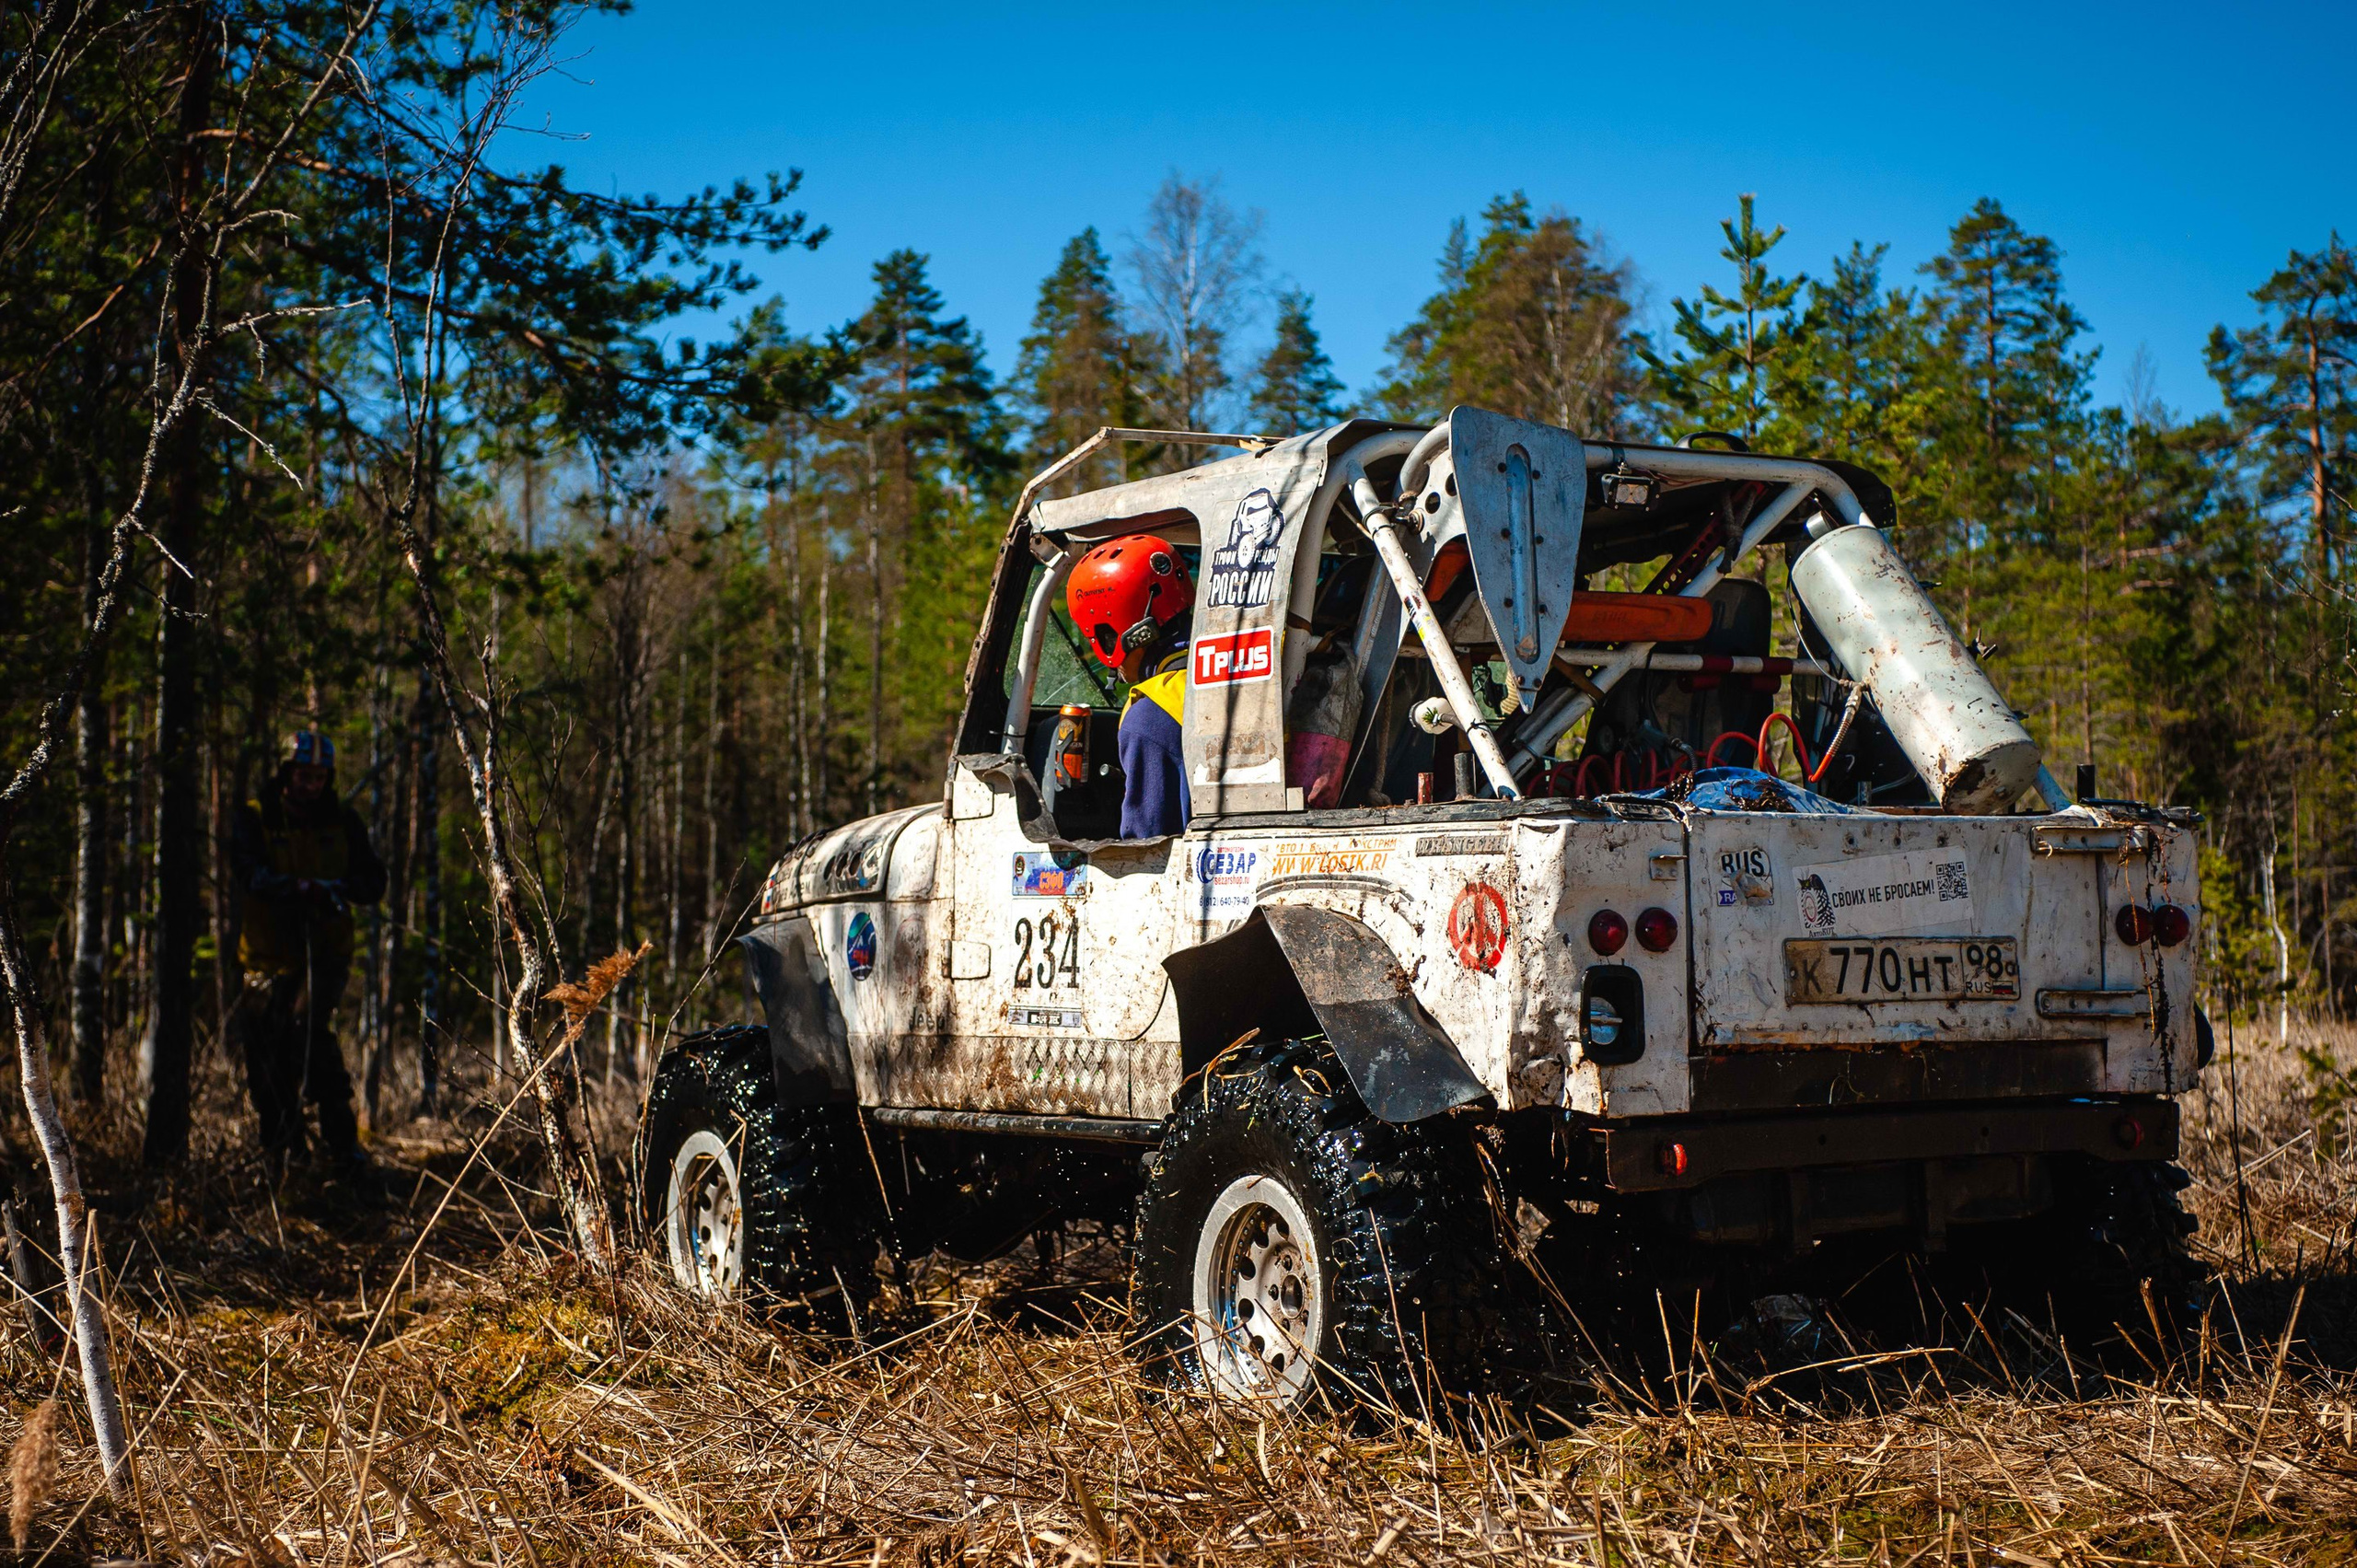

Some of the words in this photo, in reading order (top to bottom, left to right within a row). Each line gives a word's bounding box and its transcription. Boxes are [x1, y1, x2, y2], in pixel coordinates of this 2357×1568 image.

[1211, 571, 1273, 605] РОССИИ
[1207, 853, 1257, 875] СЕЗАР
[1831, 889, 1865, 909] СВОИХ
[1868, 887, 1882, 903] НЕ
[1885, 879, 1935, 902] БРОСАЕМ!
[1014, 917, 1080, 989] 234
[1966, 981, 1992, 994] RUS
